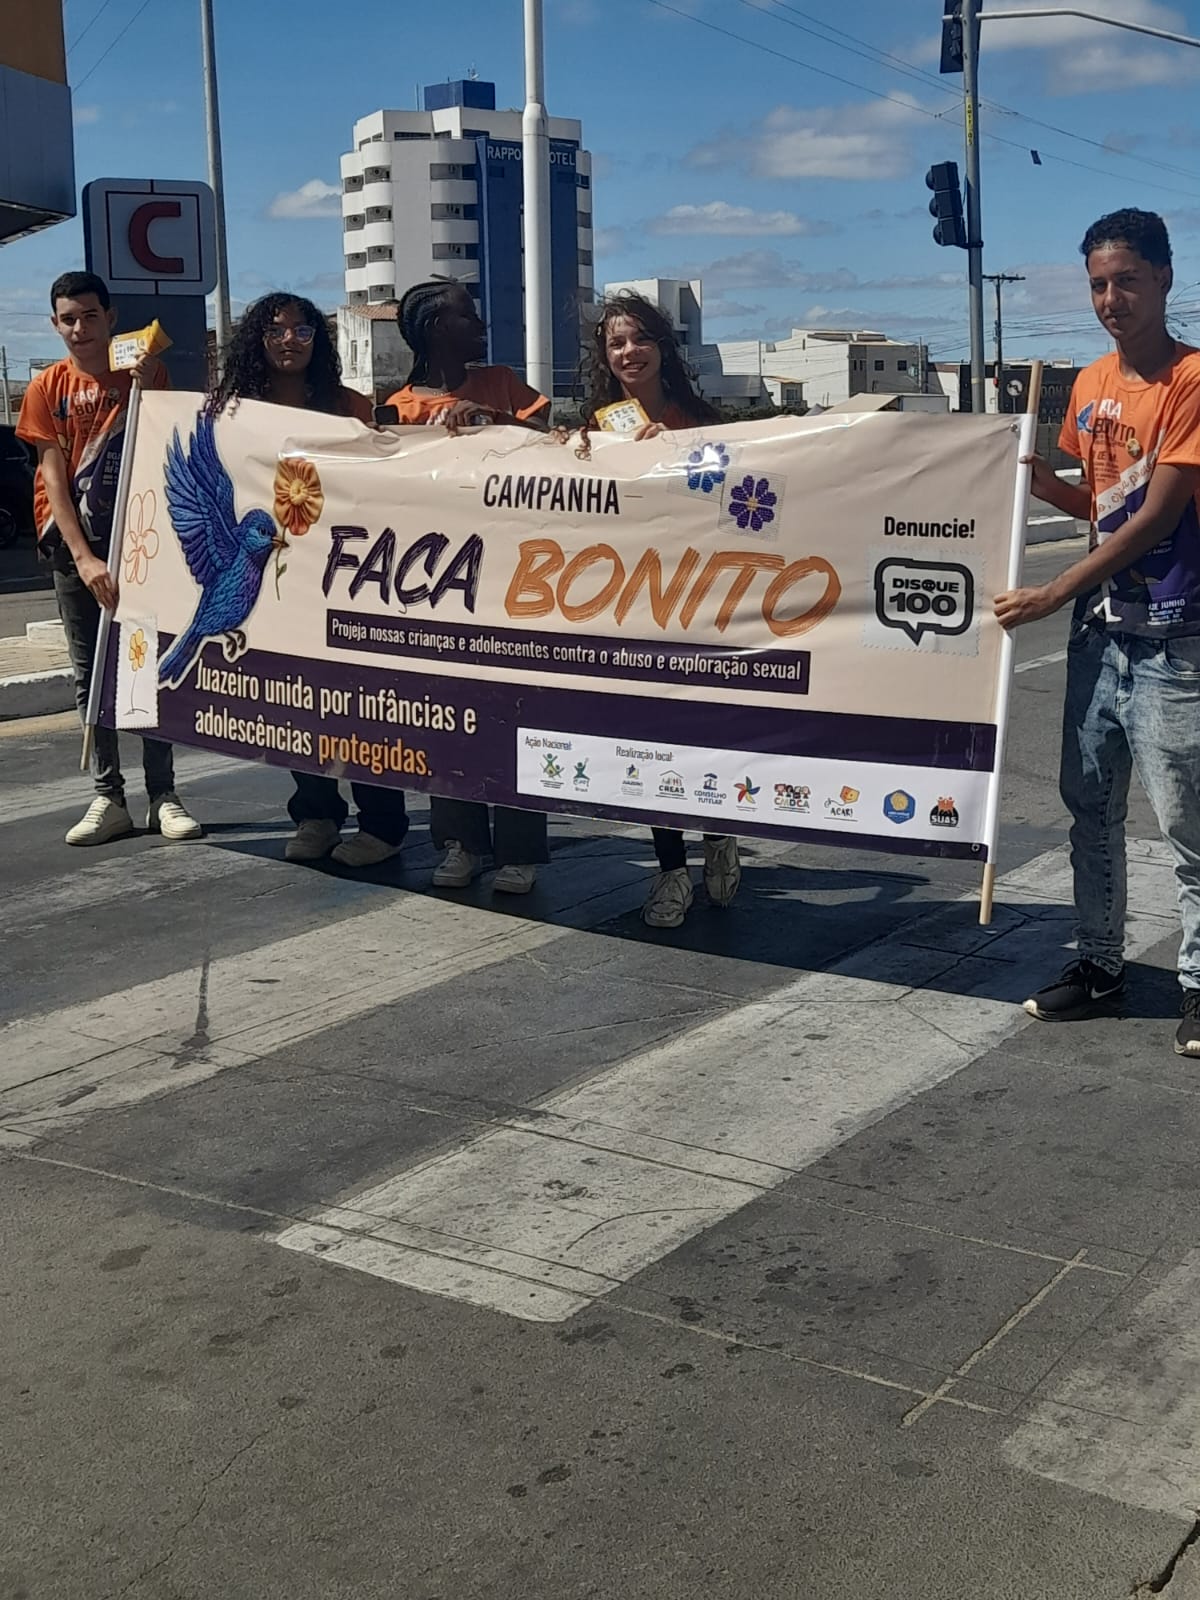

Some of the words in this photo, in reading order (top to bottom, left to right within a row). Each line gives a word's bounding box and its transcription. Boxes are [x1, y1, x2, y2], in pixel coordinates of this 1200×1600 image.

[487, 146, 522, 160] RAPPO
[549, 151, 575, 165] OTEL
[483, 474, 620, 515] CAMPANHA
[884, 516, 975, 539] Denuncie!
[322, 525, 484, 614] FAÇA
[504, 538, 842, 638] BONITO
[892, 577, 960, 594] DISQUE
[889, 591, 957, 616] 100
[332, 618, 367, 642] Projeja
[370, 627, 405, 644] nossas
[408, 629, 455, 653] crianças
[458, 638, 466, 651] e
[469, 634, 550, 659] adolescentes
[553, 645, 595, 663] contra
[600, 650, 608, 664] o
[612, 648, 652, 668] abuso
[656, 654, 665, 669] e
[669, 653, 748, 679] exploração
[752, 661, 801, 681] sexual
[195, 657, 260, 700] Juazeiro
[265, 675, 314, 710] unida
[320, 688, 352, 719] por
[358, 686, 456, 731] infâncias
[463, 708, 478, 734] e
[195, 705, 313, 756] adolescências
[318, 733, 433, 775] protegidas.
[659, 785, 685, 794] CREAS
[694, 790, 727, 800] CONSELHO
[931, 815, 957, 825] SUAS
